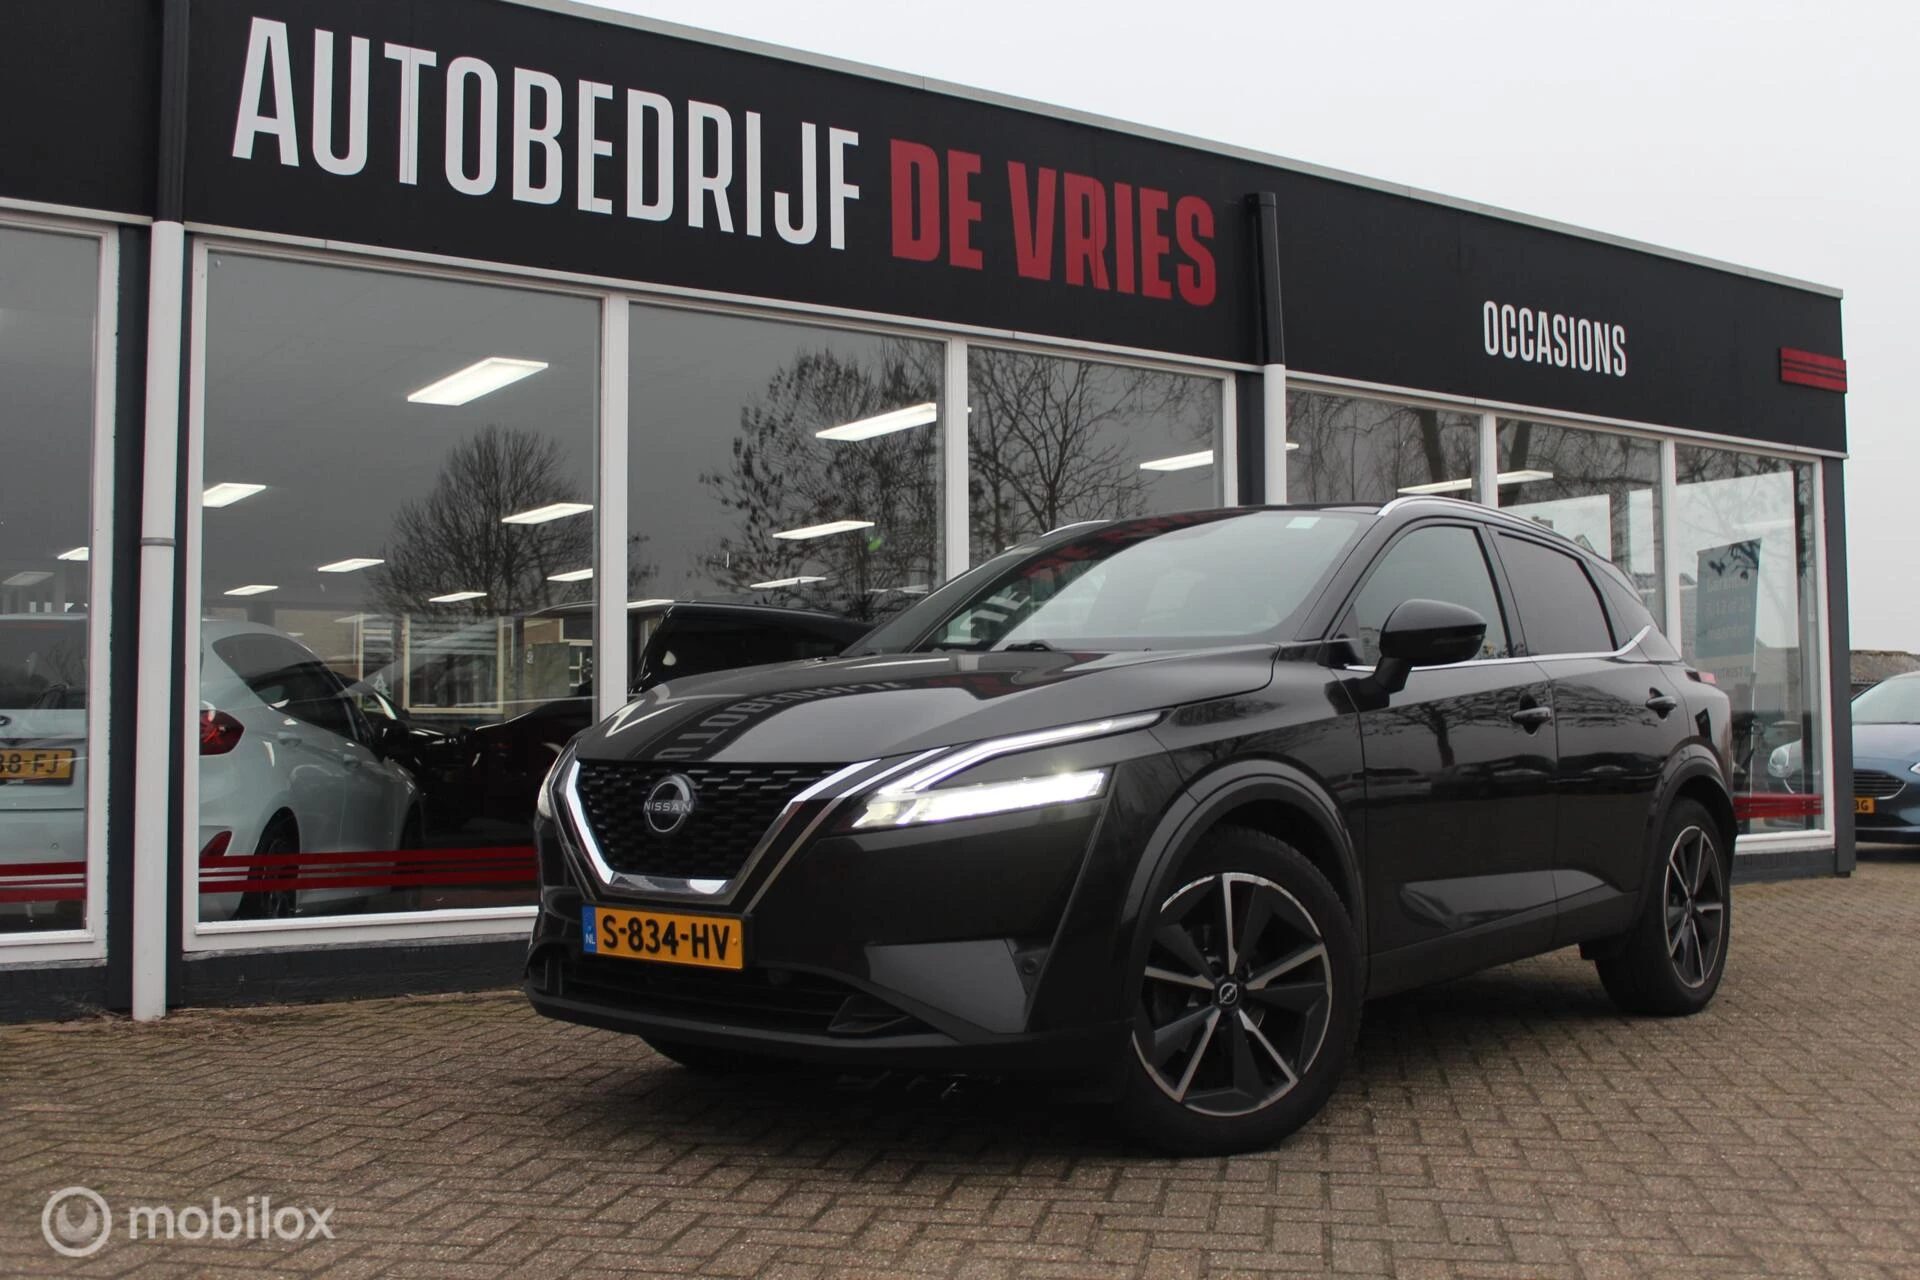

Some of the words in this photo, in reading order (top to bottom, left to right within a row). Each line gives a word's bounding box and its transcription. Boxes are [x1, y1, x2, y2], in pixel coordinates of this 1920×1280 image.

[232, 17, 860, 251] AUTOBEDRIJF
[890, 139, 983, 271] DE
[1007, 161, 1217, 306] VRIES
[1483, 301, 1627, 377] OCCASIONS
[643, 801, 692, 812] NISSAN
[585, 934, 596, 945] NL
[602, 915, 730, 960] S-834-HV
